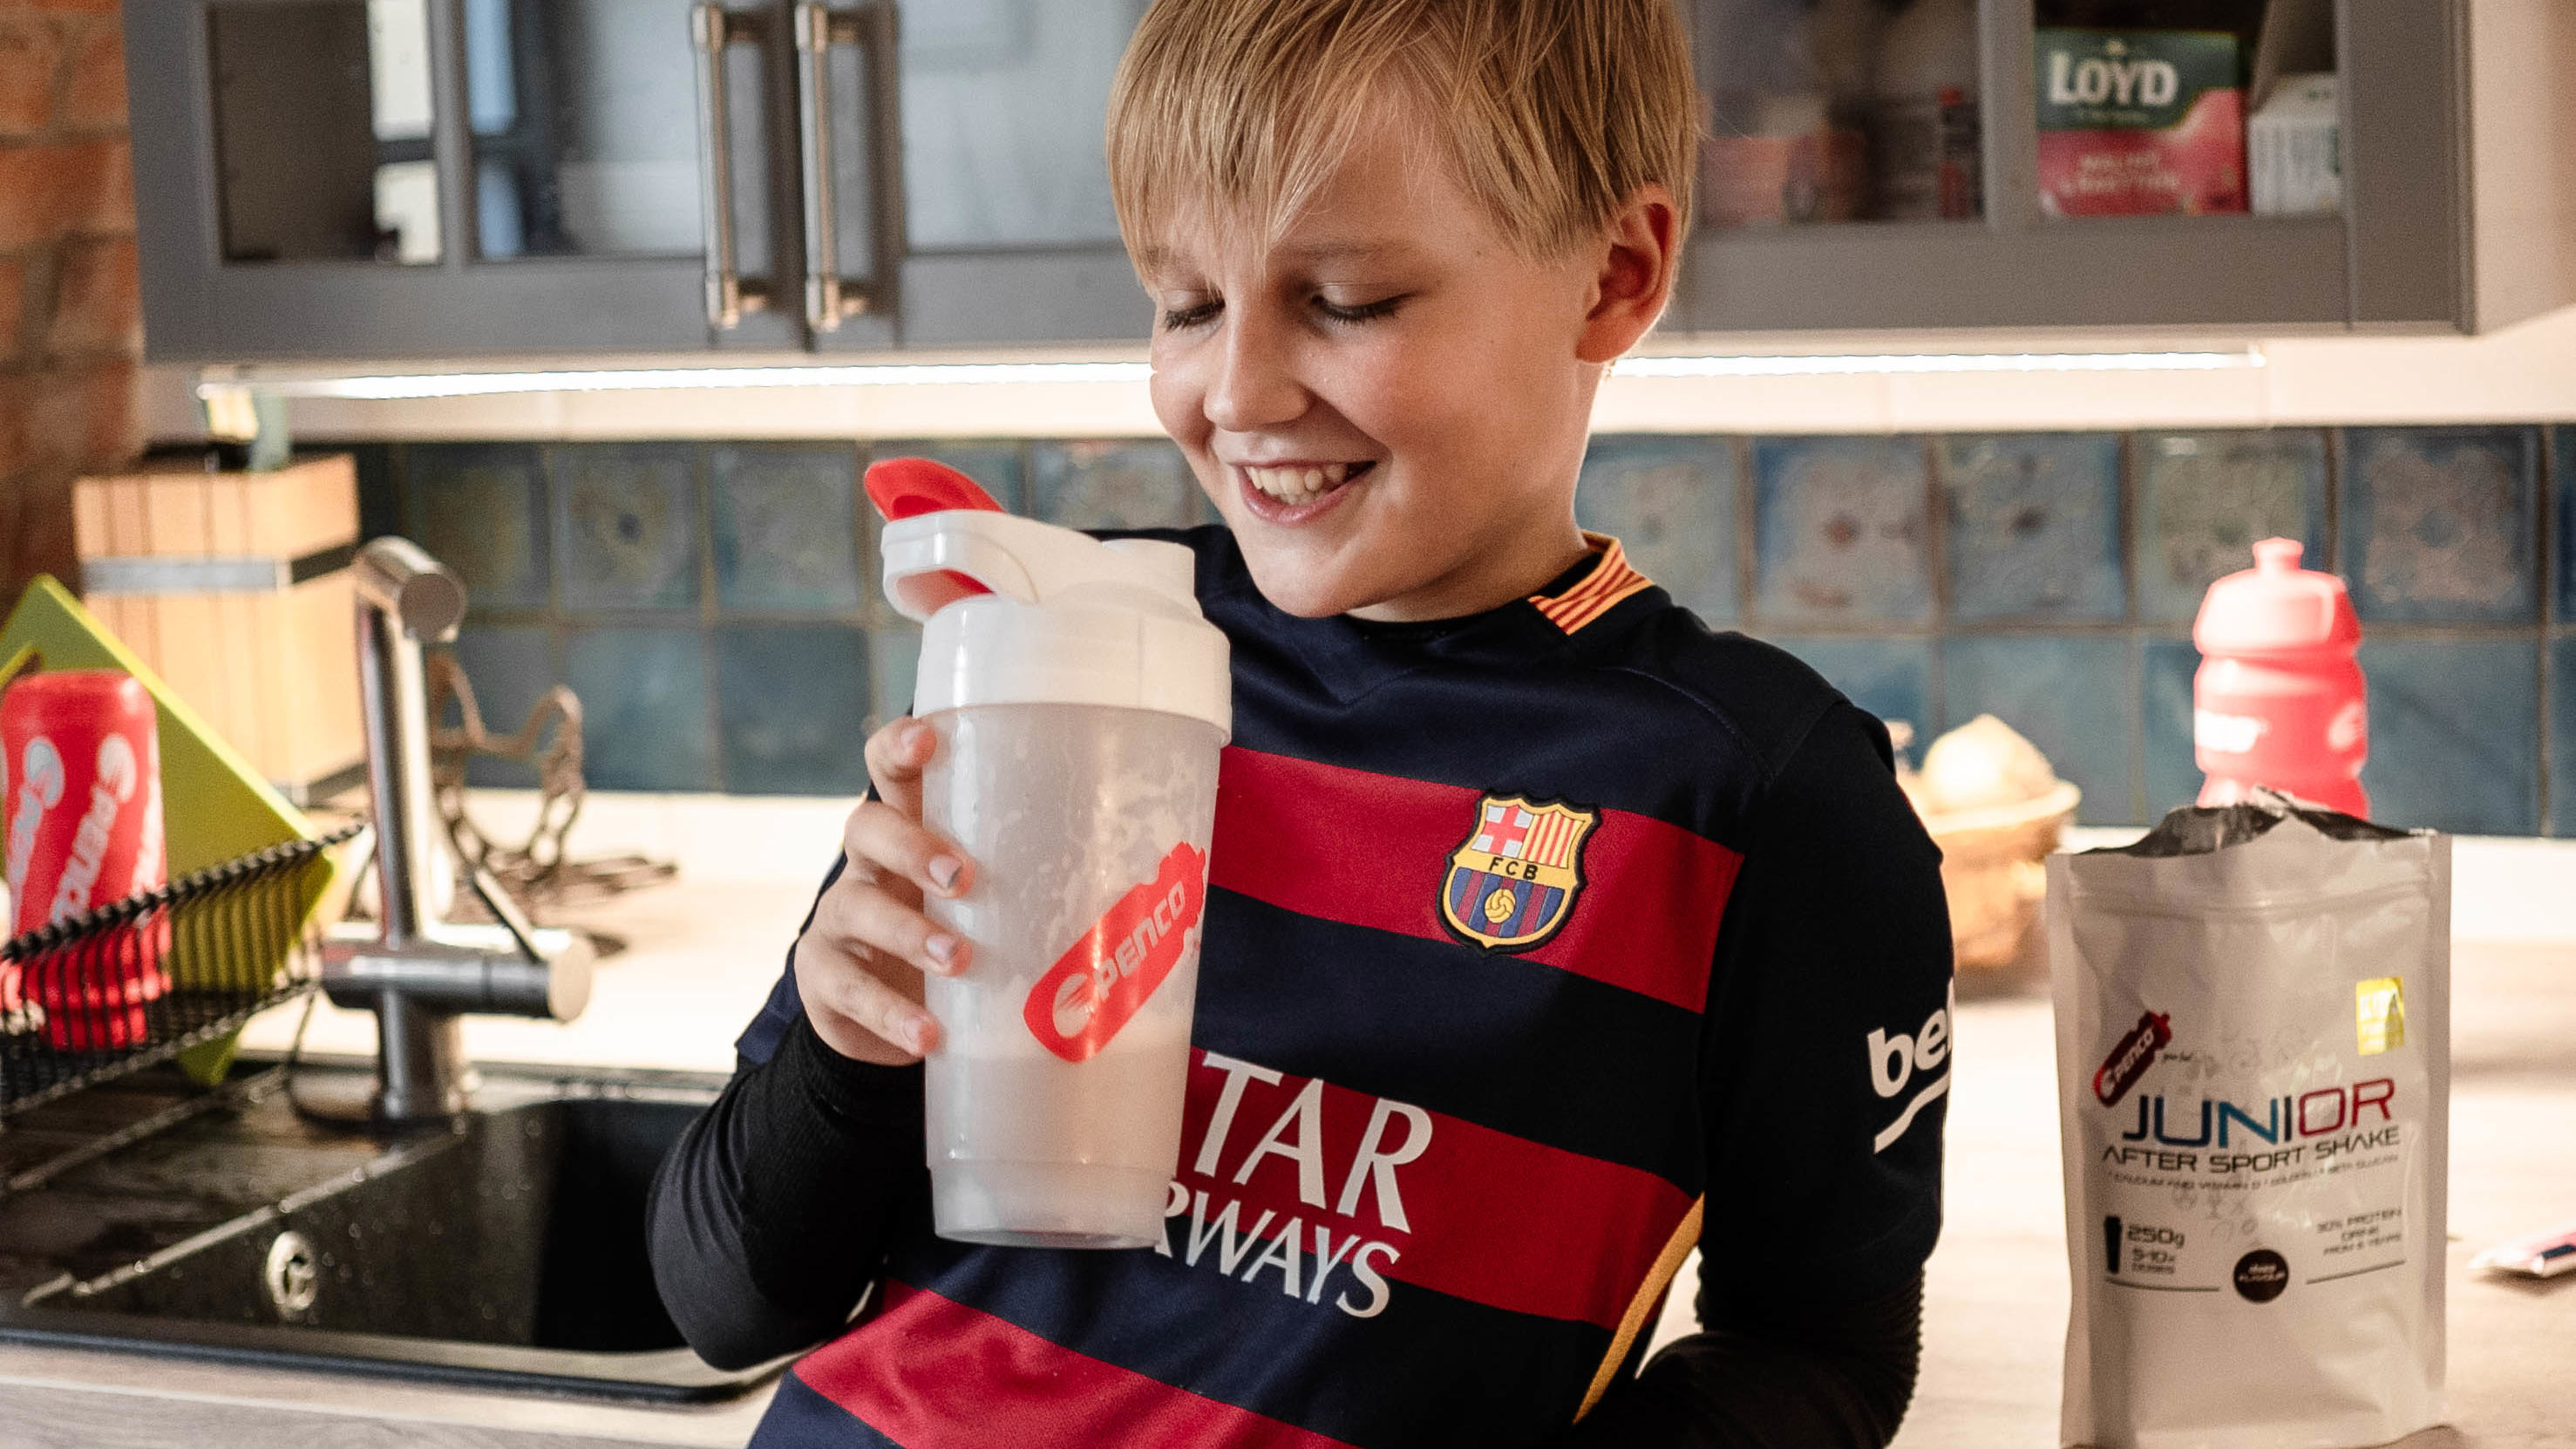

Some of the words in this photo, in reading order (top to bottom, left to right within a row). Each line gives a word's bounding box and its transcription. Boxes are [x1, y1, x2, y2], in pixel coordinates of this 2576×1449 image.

[2049, 50, 2178, 106] LOYD
[1091, 880, 1186, 1000] PENCO
[2122, 1078, 2396, 1149] JUNIOR
[1193, 1051, 1433, 1235] TAR
[2102, 1145, 2198, 1173] AFTER
[2209, 1145, 2307, 1173] SPORT
[2314, 1126, 2401, 1160] SHAKE
[2128, 1224, 2185, 1249] 250g
[2348, 1207, 2403, 1226] PROTEIN
